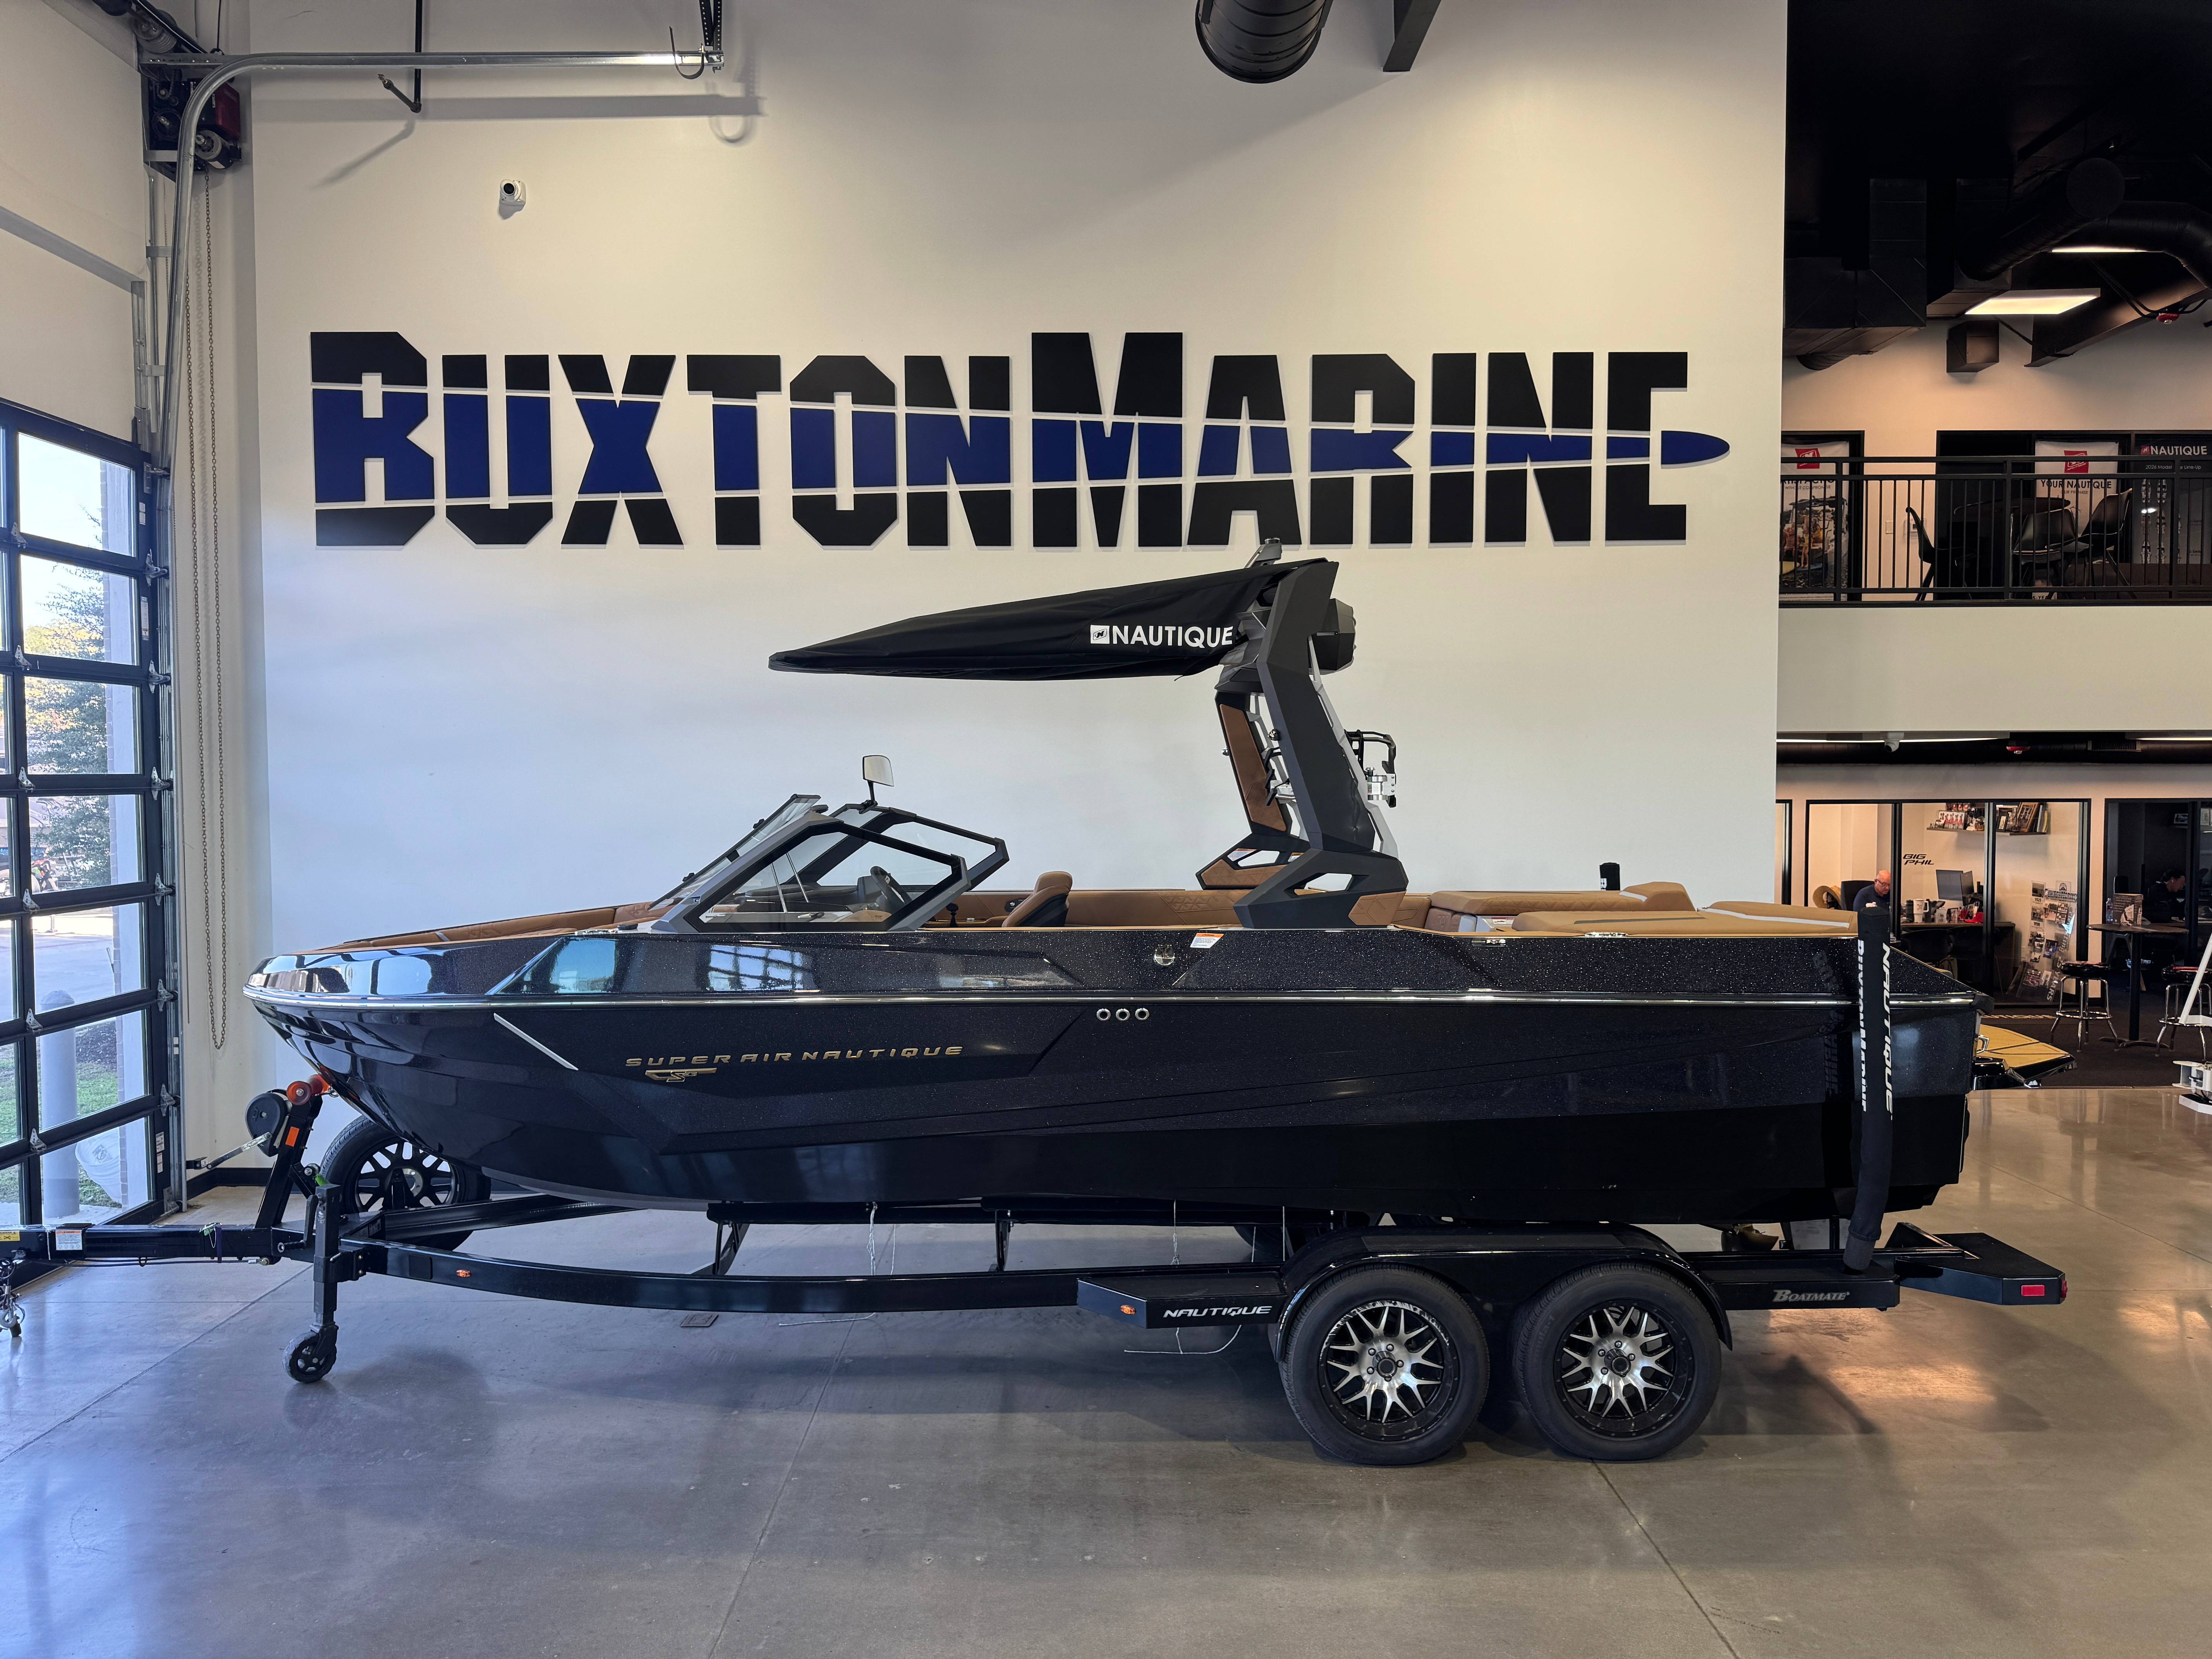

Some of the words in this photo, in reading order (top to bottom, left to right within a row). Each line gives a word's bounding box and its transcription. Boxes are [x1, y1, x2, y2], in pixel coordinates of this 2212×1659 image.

[2150, 446, 2207, 455] NAUTIQUE
[2067, 481, 2111, 489] NAUTQUE
[1113, 625, 1233, 648] NAUTIQUE
[1883, 943, 1893, 1113] NAUTIQUE
[626, 1055, 731, 1066] SUPER
[740, 1053, 792, 1063] AIR
[802, 1047, 963, 1060] NAUTIQUE
[1772, 1290, 1846, 1302] BOATMATE
[1163, 1306, 1273, 1317] NAUTIQUE
